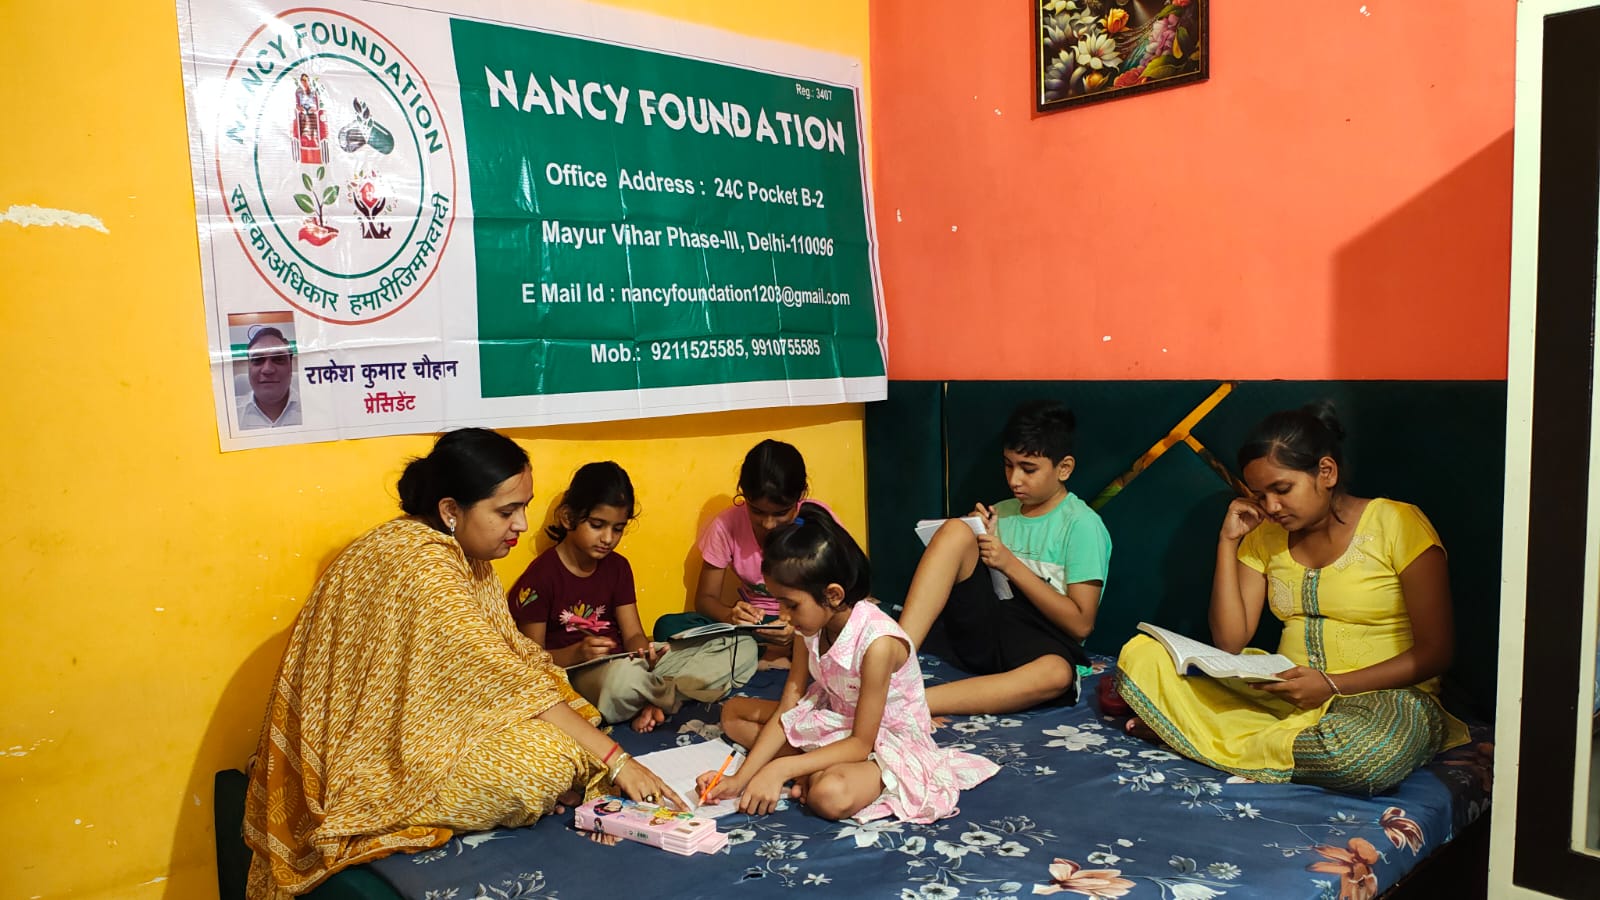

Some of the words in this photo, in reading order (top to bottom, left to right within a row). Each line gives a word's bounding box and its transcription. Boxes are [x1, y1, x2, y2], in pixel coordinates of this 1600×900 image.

[293, 21, 444, 154] FOUNDATION
[815, 87, 833, 101] 3407
[484, 65, 630, 125] NANCY
[638, 88, 846, 156] FOUNDATION
[545, 162, 607, 189] Office
[618, 168, 695, 195] Address
[714, 176, 744, 200] 24C
[747, 180, 799, 206] Pocket
[801, 187, 825, 209] B-2
[541, 220, 607, 250] Mayur
[611, 223, 662, 248] Vihar
[667, 226, 745, 253] Phase-III,
[748, 231, 834, 257] Delhi-110096
[521, 283, 536, 304] E
[541, 282, 582, 304] Mail
[587, 282, 605, 304] Id
[621, 281, 851, 308] nancyfoundation1203@gmail.com
[651, 340, 749, 361] 9211525585,
[751, 338, 821, 356] 9910755585
[304, 359, 356, 385] राकेश
[361, 361, 408, 388] कुमार
[412, 354, 459, 380] चौहान
[363, 390, 416, 414] प्रेसिडेंट
